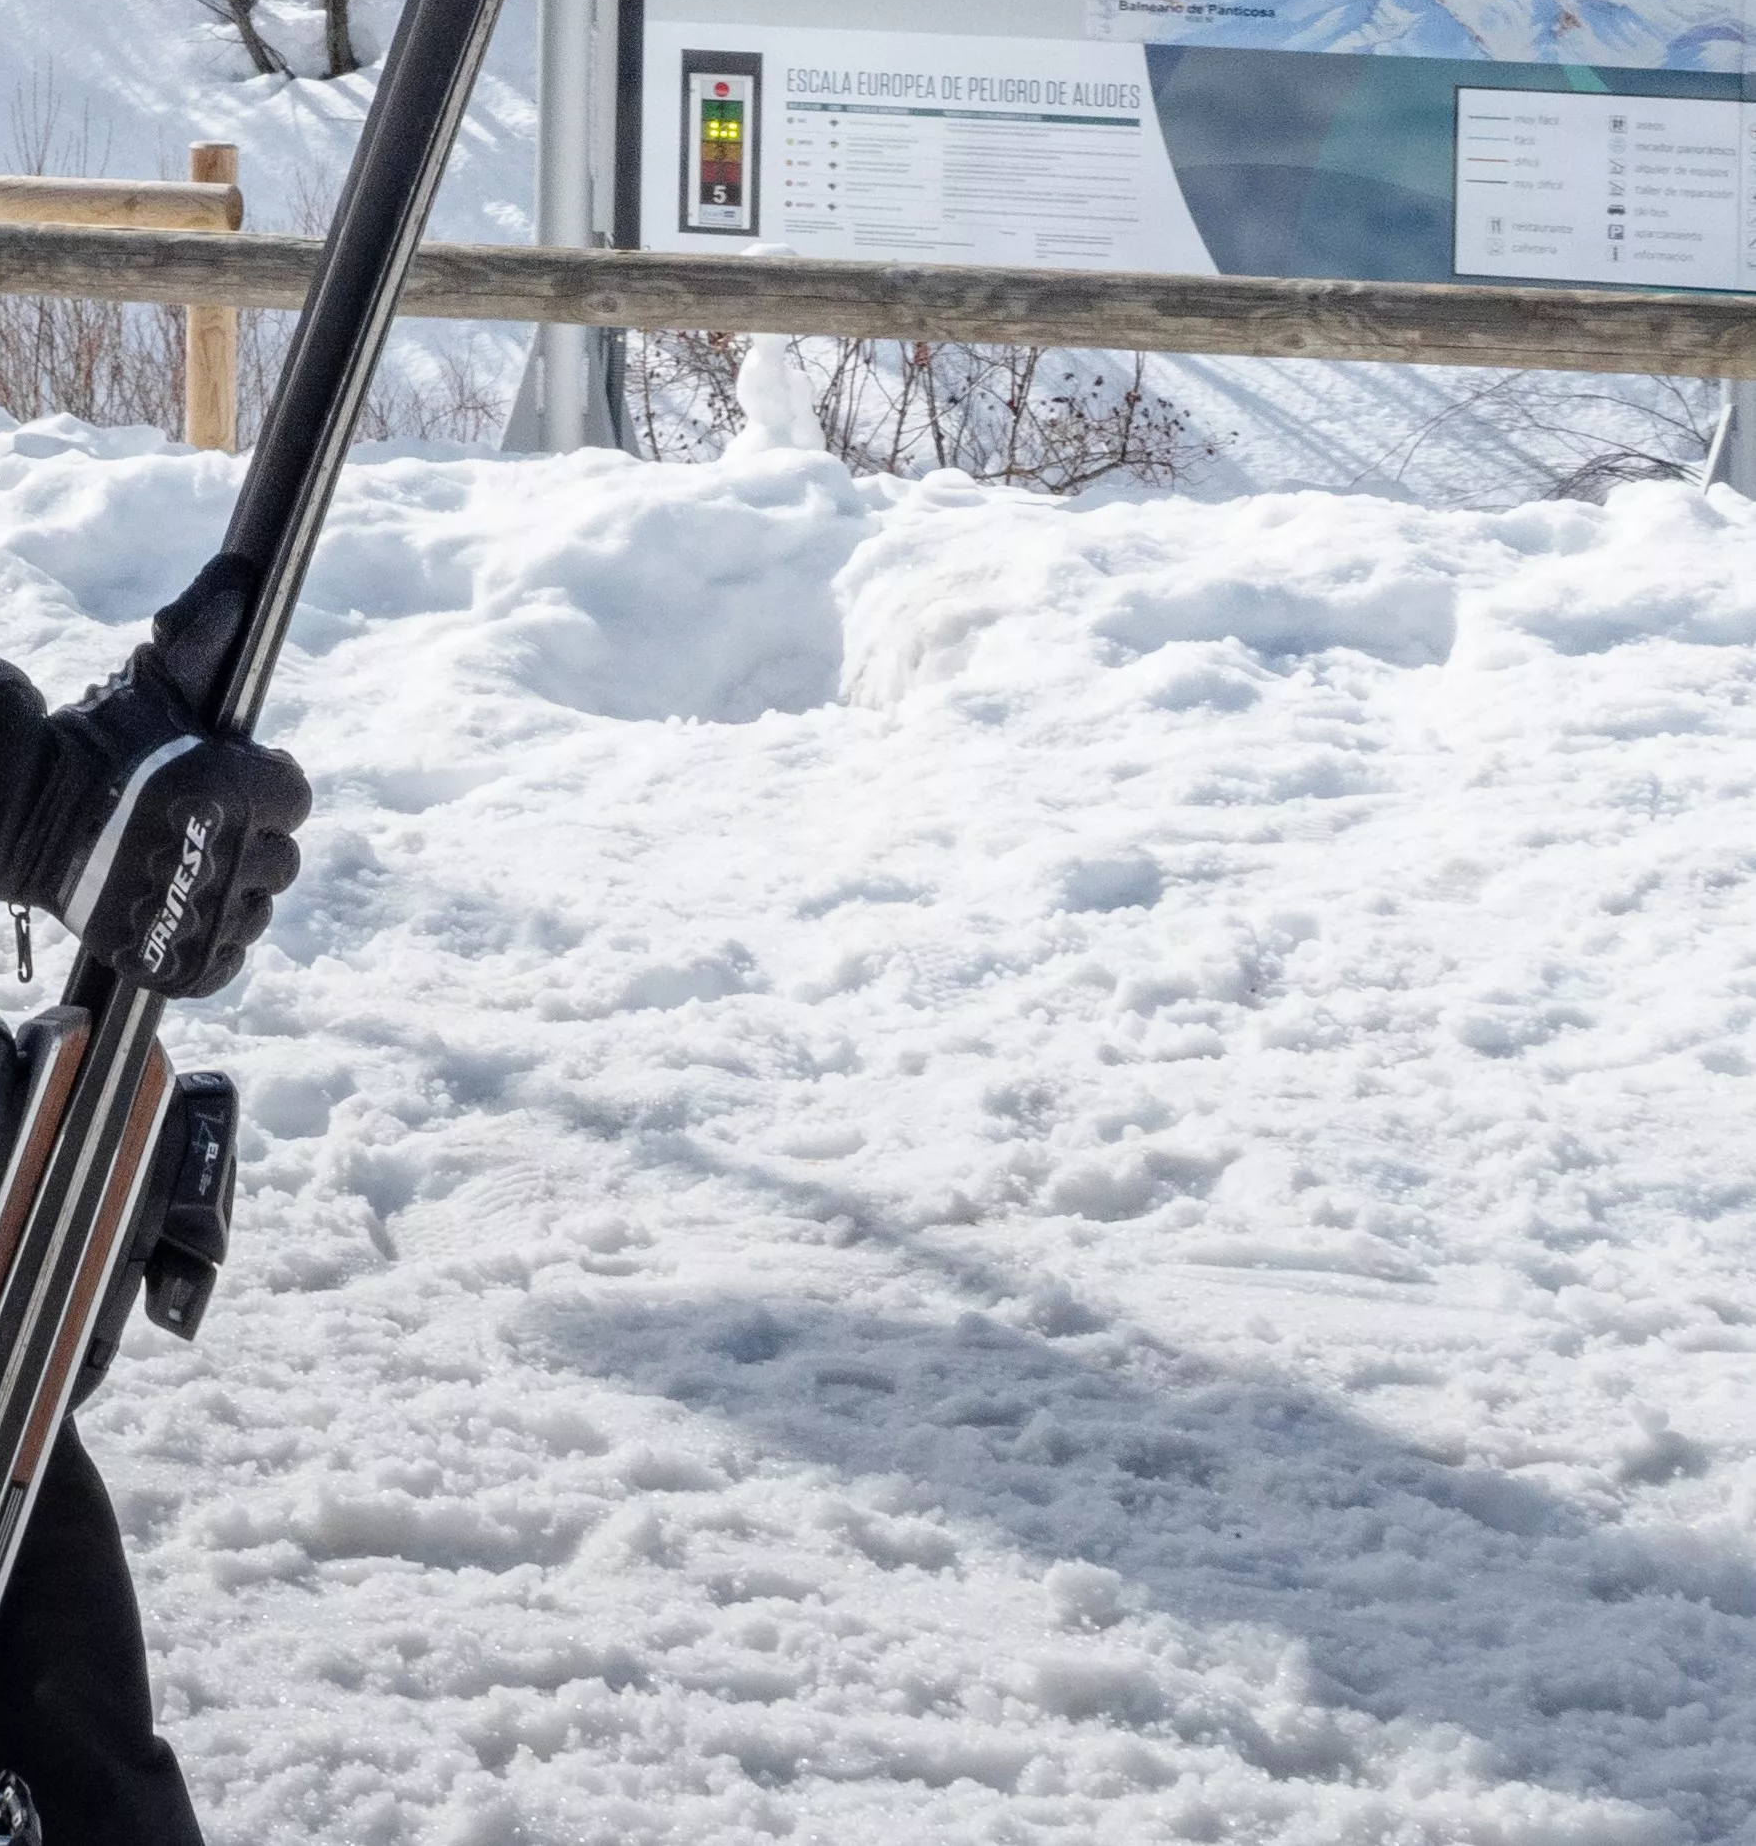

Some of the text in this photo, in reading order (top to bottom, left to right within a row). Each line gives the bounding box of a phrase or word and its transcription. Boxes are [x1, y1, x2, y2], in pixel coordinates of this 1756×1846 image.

[1119, 0, 1275, 18] Balneario de Panticosa
[787, 68, 1141, 109] ESCALA EUROPEA DE PELIGRO DE ALUDES
[713, 184, 727, 204] 5
[143, 816, 209, 975] DAINESE
